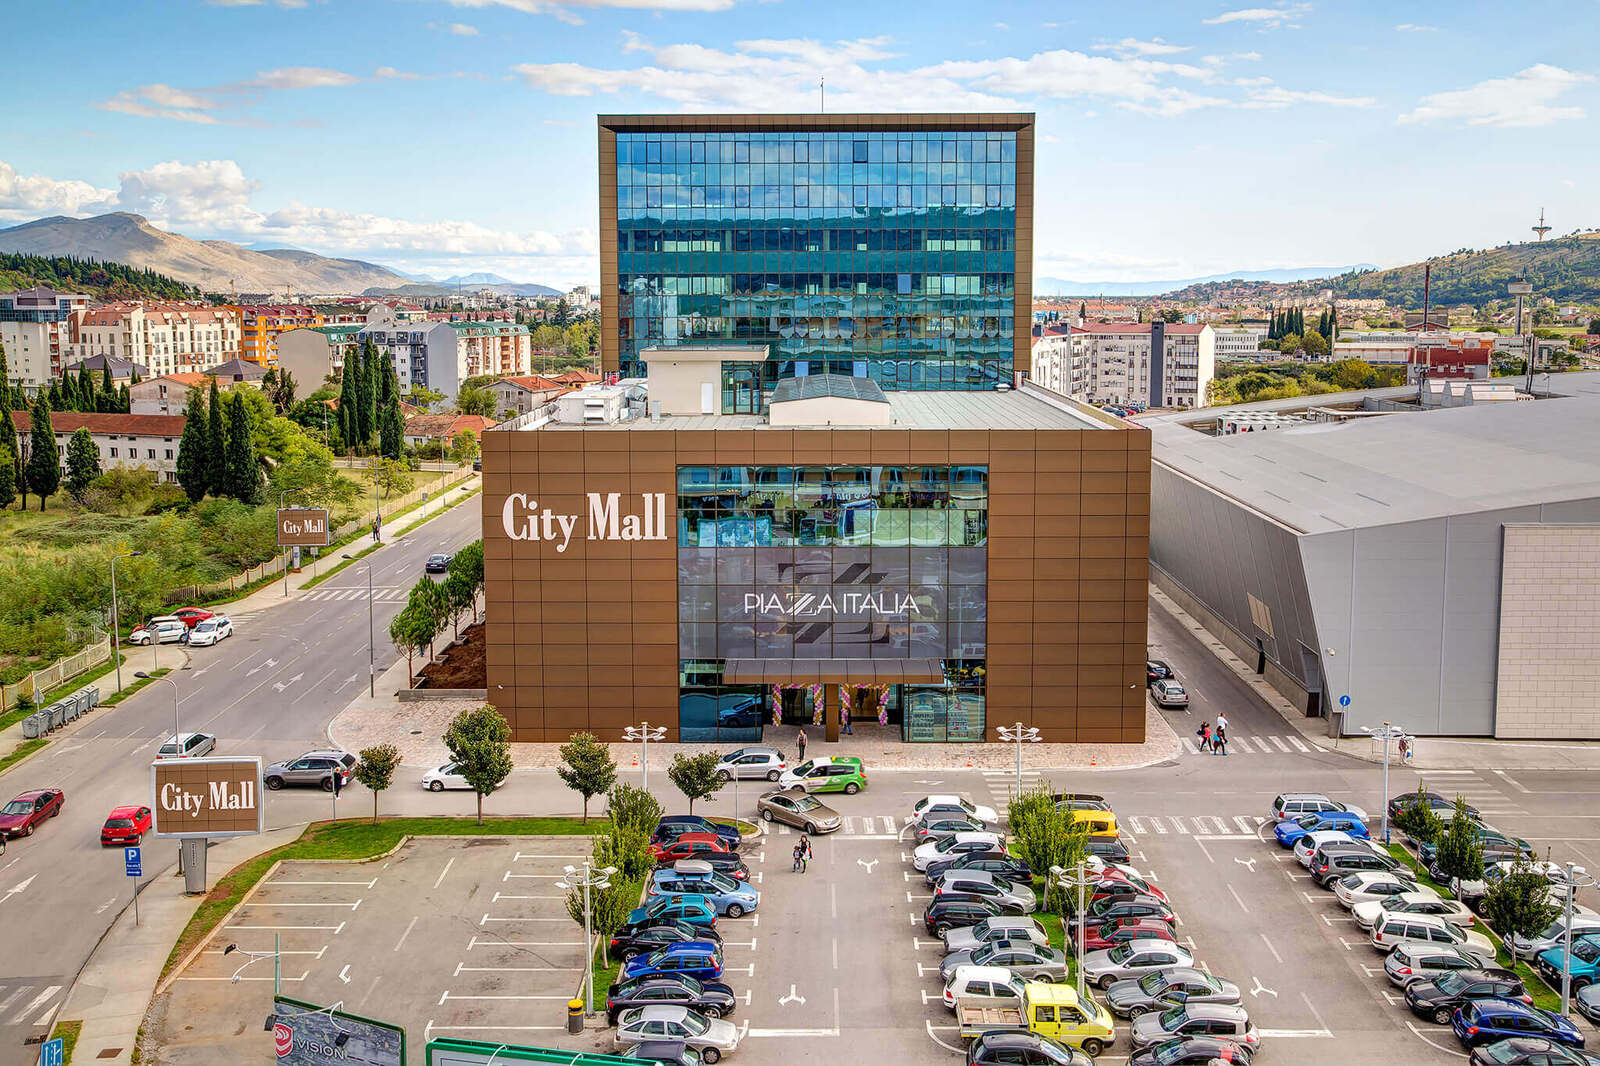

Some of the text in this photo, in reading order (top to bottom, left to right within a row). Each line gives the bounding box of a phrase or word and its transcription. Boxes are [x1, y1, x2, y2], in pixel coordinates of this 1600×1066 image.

[283, 519, 324, 536] City Mall
[502, 492, 668, 553] City Mall
[843, 593, 920, 614] ITALIA
[161, 781, 255, 817] City Mall
[128, 849, 137, 861] P
[296, 1038, 345, 1059] VISION
